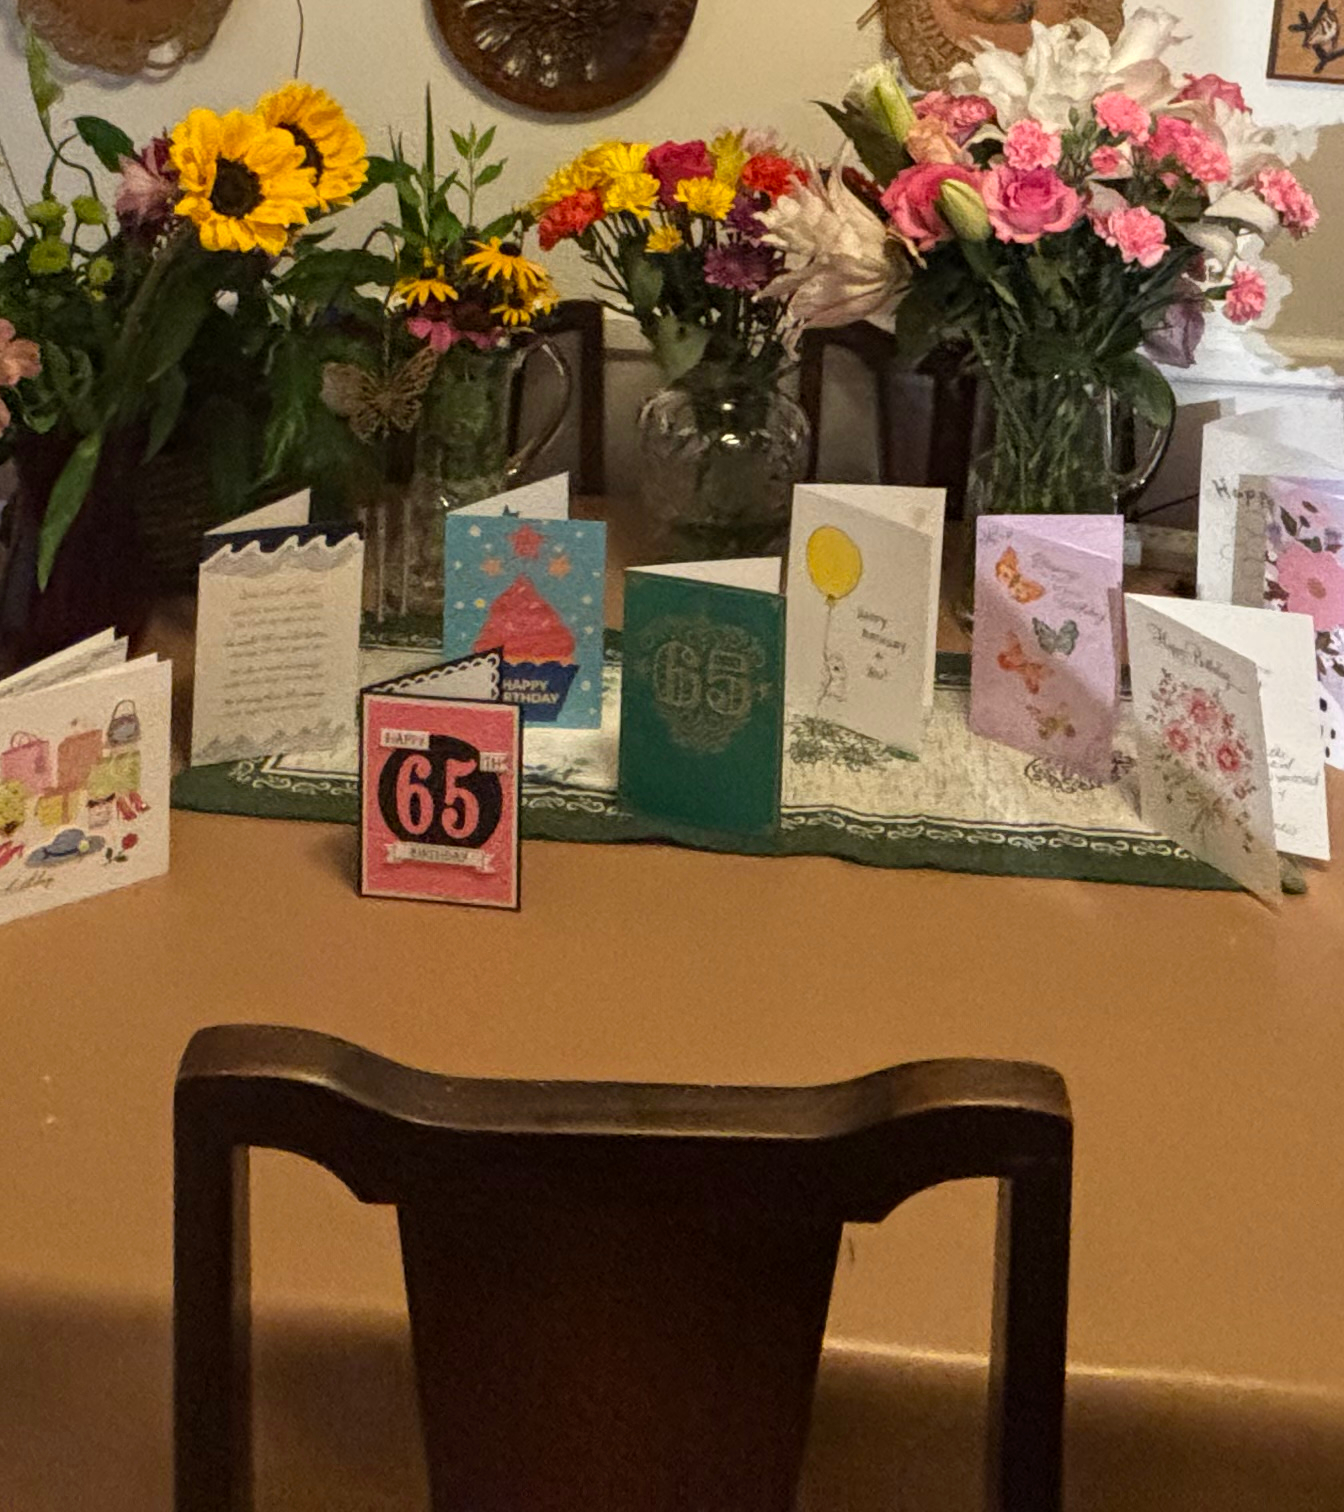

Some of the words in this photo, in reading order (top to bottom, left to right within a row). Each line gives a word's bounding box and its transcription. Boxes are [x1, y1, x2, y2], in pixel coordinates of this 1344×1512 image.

[502, 678, 549, 692] HAPPY
[502, 691, 560, 704] RTHDAY
[655, 641, 752, 717] 65
[396, 754, 480, 839] 65
